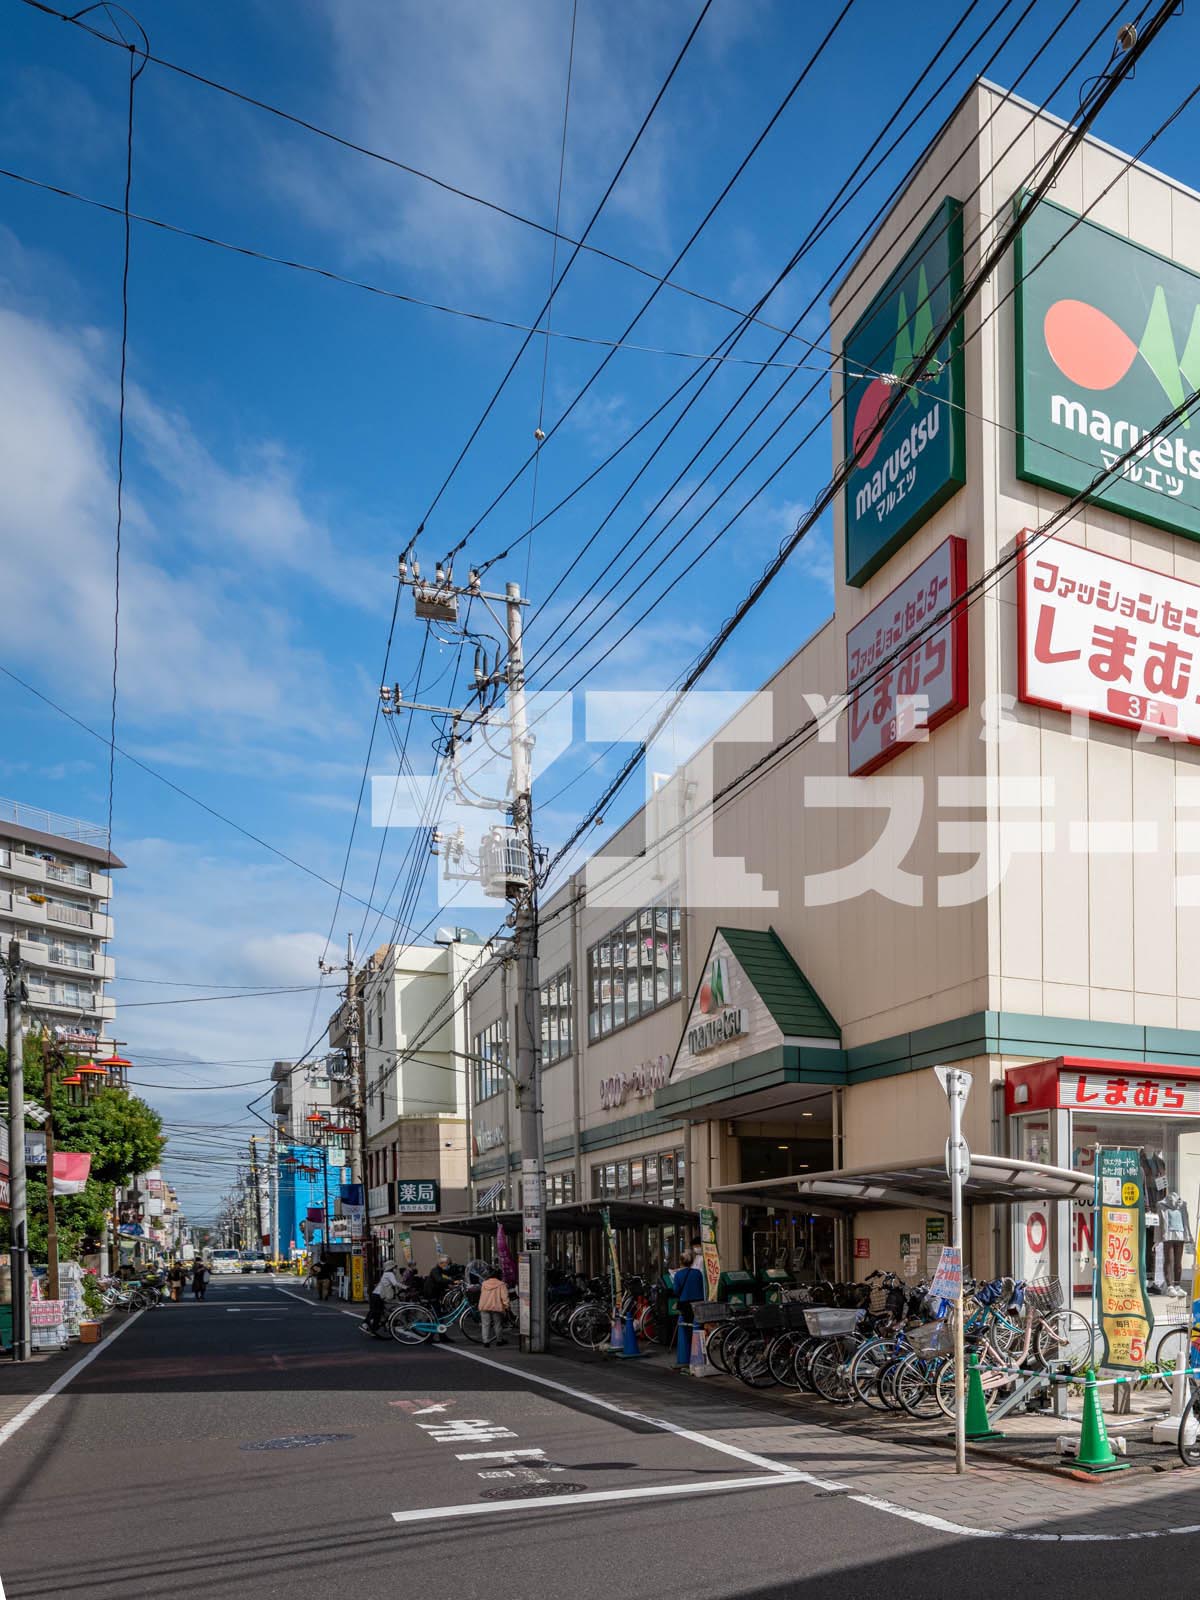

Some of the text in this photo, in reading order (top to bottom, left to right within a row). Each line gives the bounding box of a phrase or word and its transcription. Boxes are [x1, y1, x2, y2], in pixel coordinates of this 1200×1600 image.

[856, 403, 940, 521] maruetsu
[1100, 449, 1184, 496] マルエツ
[876, 466, 917, 522] マルエツ
[850, 575, 948, 681] ファッションセンター
[850, 614, 948, 743] しまむら
[1127, 695, 1161, 721] 3F
[688, 1009, 743, 1056] maruetsu
[1075, 1075, 1188, 1109] しまむら
[400, 1184, 434, 1202] 薬局
[1107, 1234, 1133, 1261] 5%
